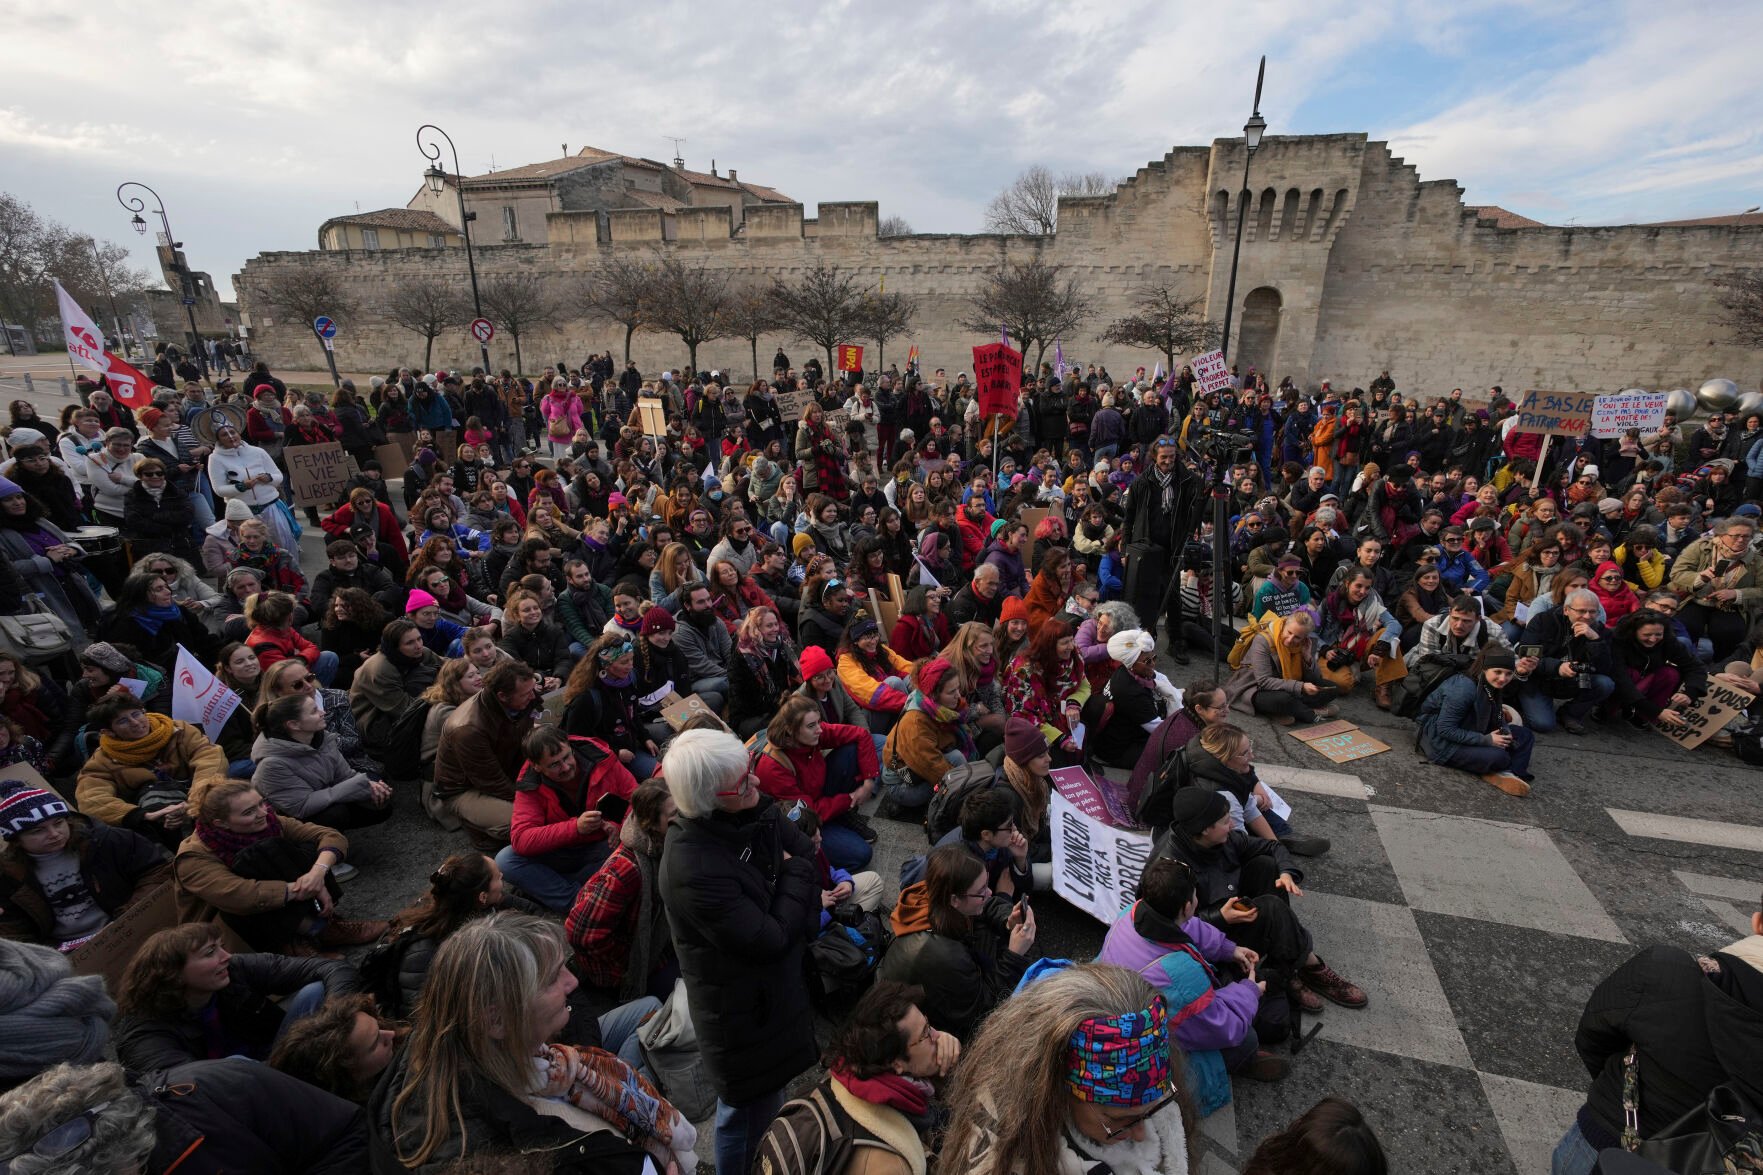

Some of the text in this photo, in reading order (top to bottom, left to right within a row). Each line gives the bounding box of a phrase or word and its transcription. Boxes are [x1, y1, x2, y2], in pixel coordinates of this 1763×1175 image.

[846, 347, 857, 369] NPA
[1192, 352, 1224, 368] VIOLEUR
[1211, 362, 1222, 370] TE
[1197, 370, 1228, 384] TRAQUERA
[780, 403, 800, 413] NOS
[1542, 395, 1573, 412] BAS
[1575, 398, 1593, 413] LE
[293, 449, 343, 468] FEMME
[309, 466, 336, 480] VIE
[299, 480, 346, 499] LIBERT
[1313, 734, 1353, 751] STOP
[1062, 811, 1096, 902] L'HONNEUR
[1094, 859, 1114, 891] FACE
